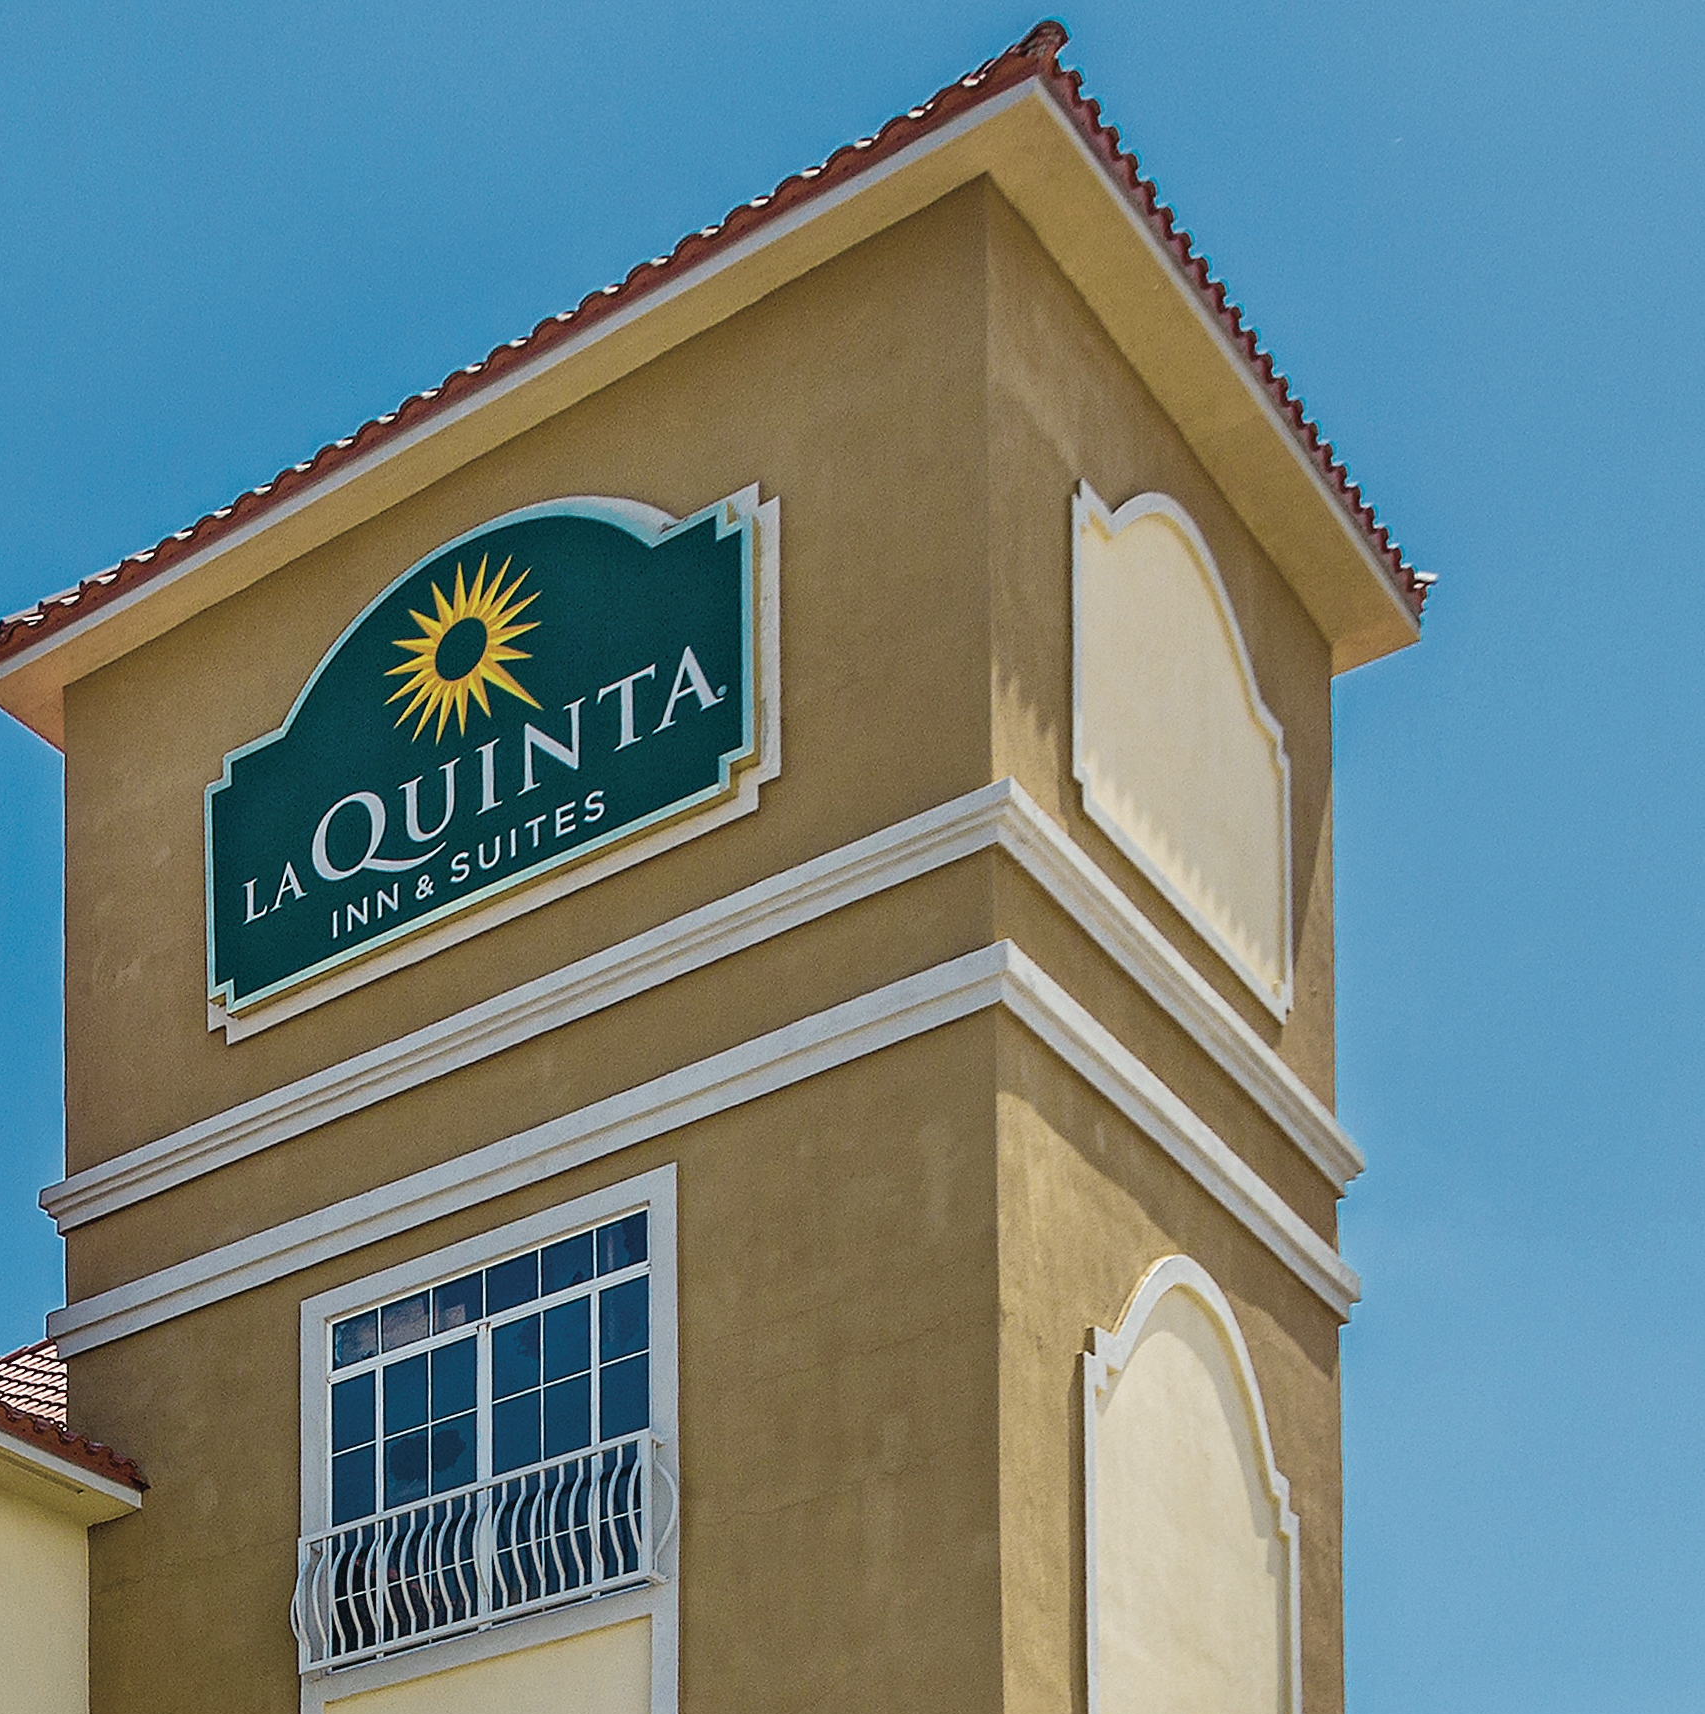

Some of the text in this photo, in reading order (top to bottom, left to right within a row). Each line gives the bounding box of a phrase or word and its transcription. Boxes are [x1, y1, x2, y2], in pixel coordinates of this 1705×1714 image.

[242, 644, 725, 925] LA QUINTA
[331, 789, 606, 939] INN & SUITES
